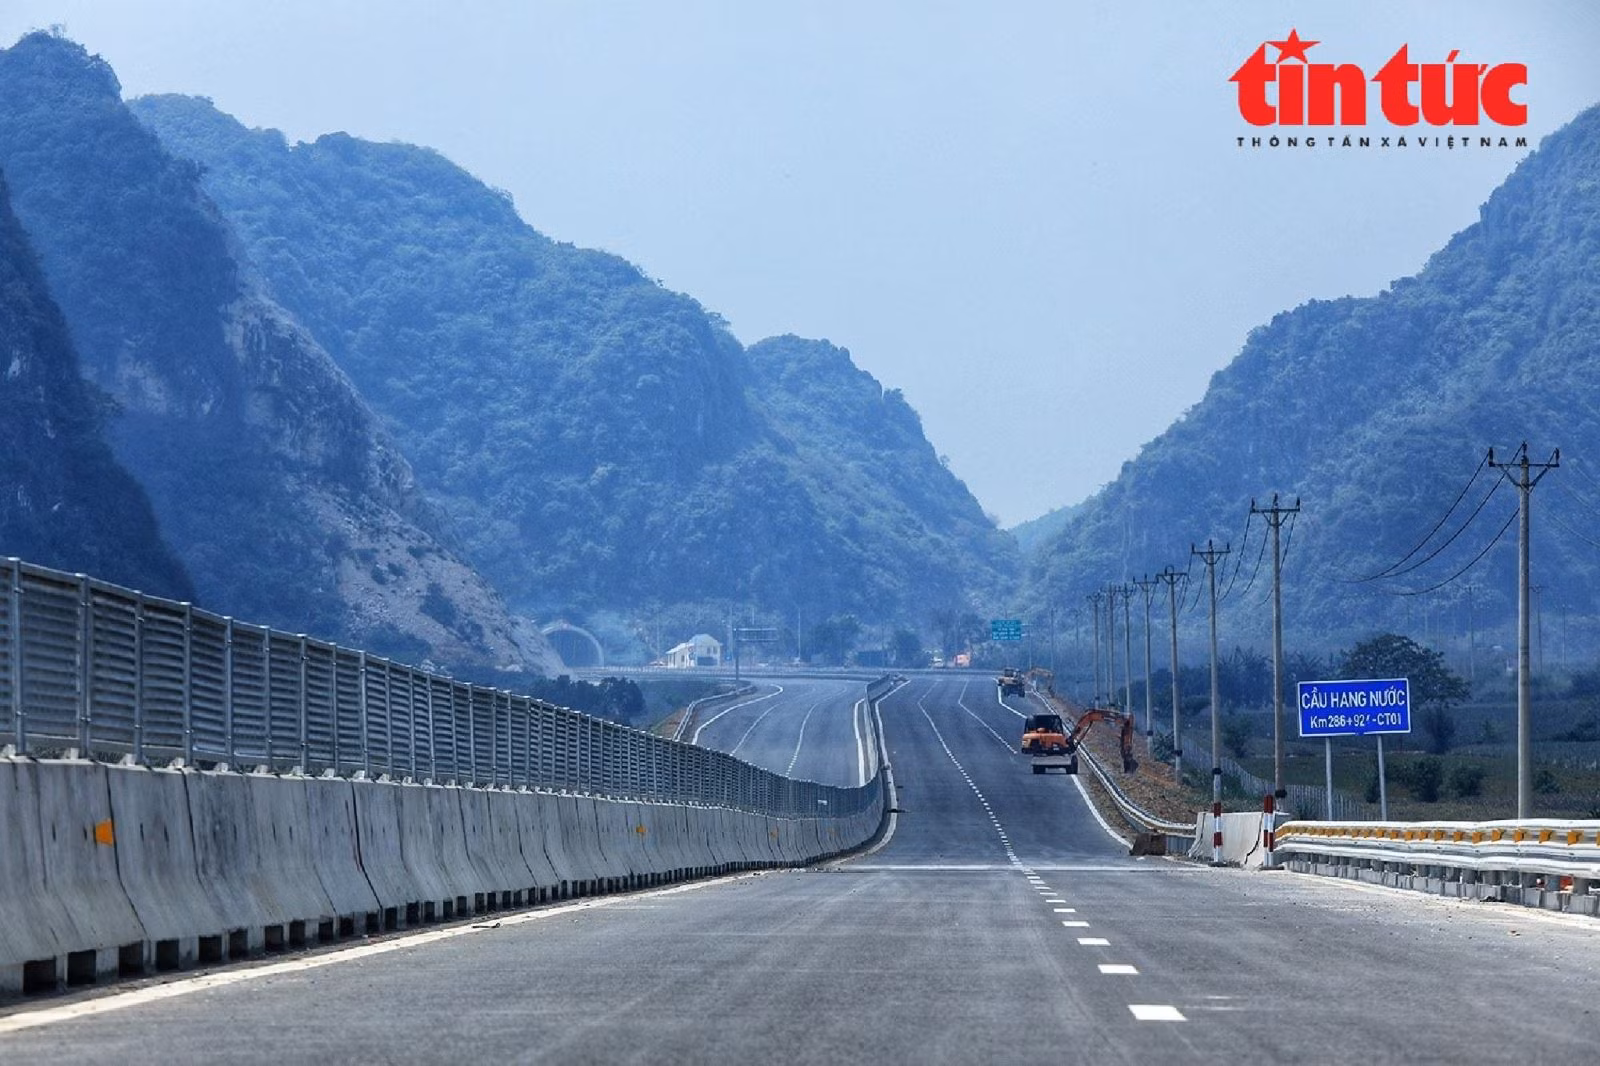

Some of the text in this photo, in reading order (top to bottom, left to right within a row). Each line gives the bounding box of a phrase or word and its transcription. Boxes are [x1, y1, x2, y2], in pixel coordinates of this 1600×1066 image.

[1302, 686, 1405, 709] CẦU HANG NƯỚC
